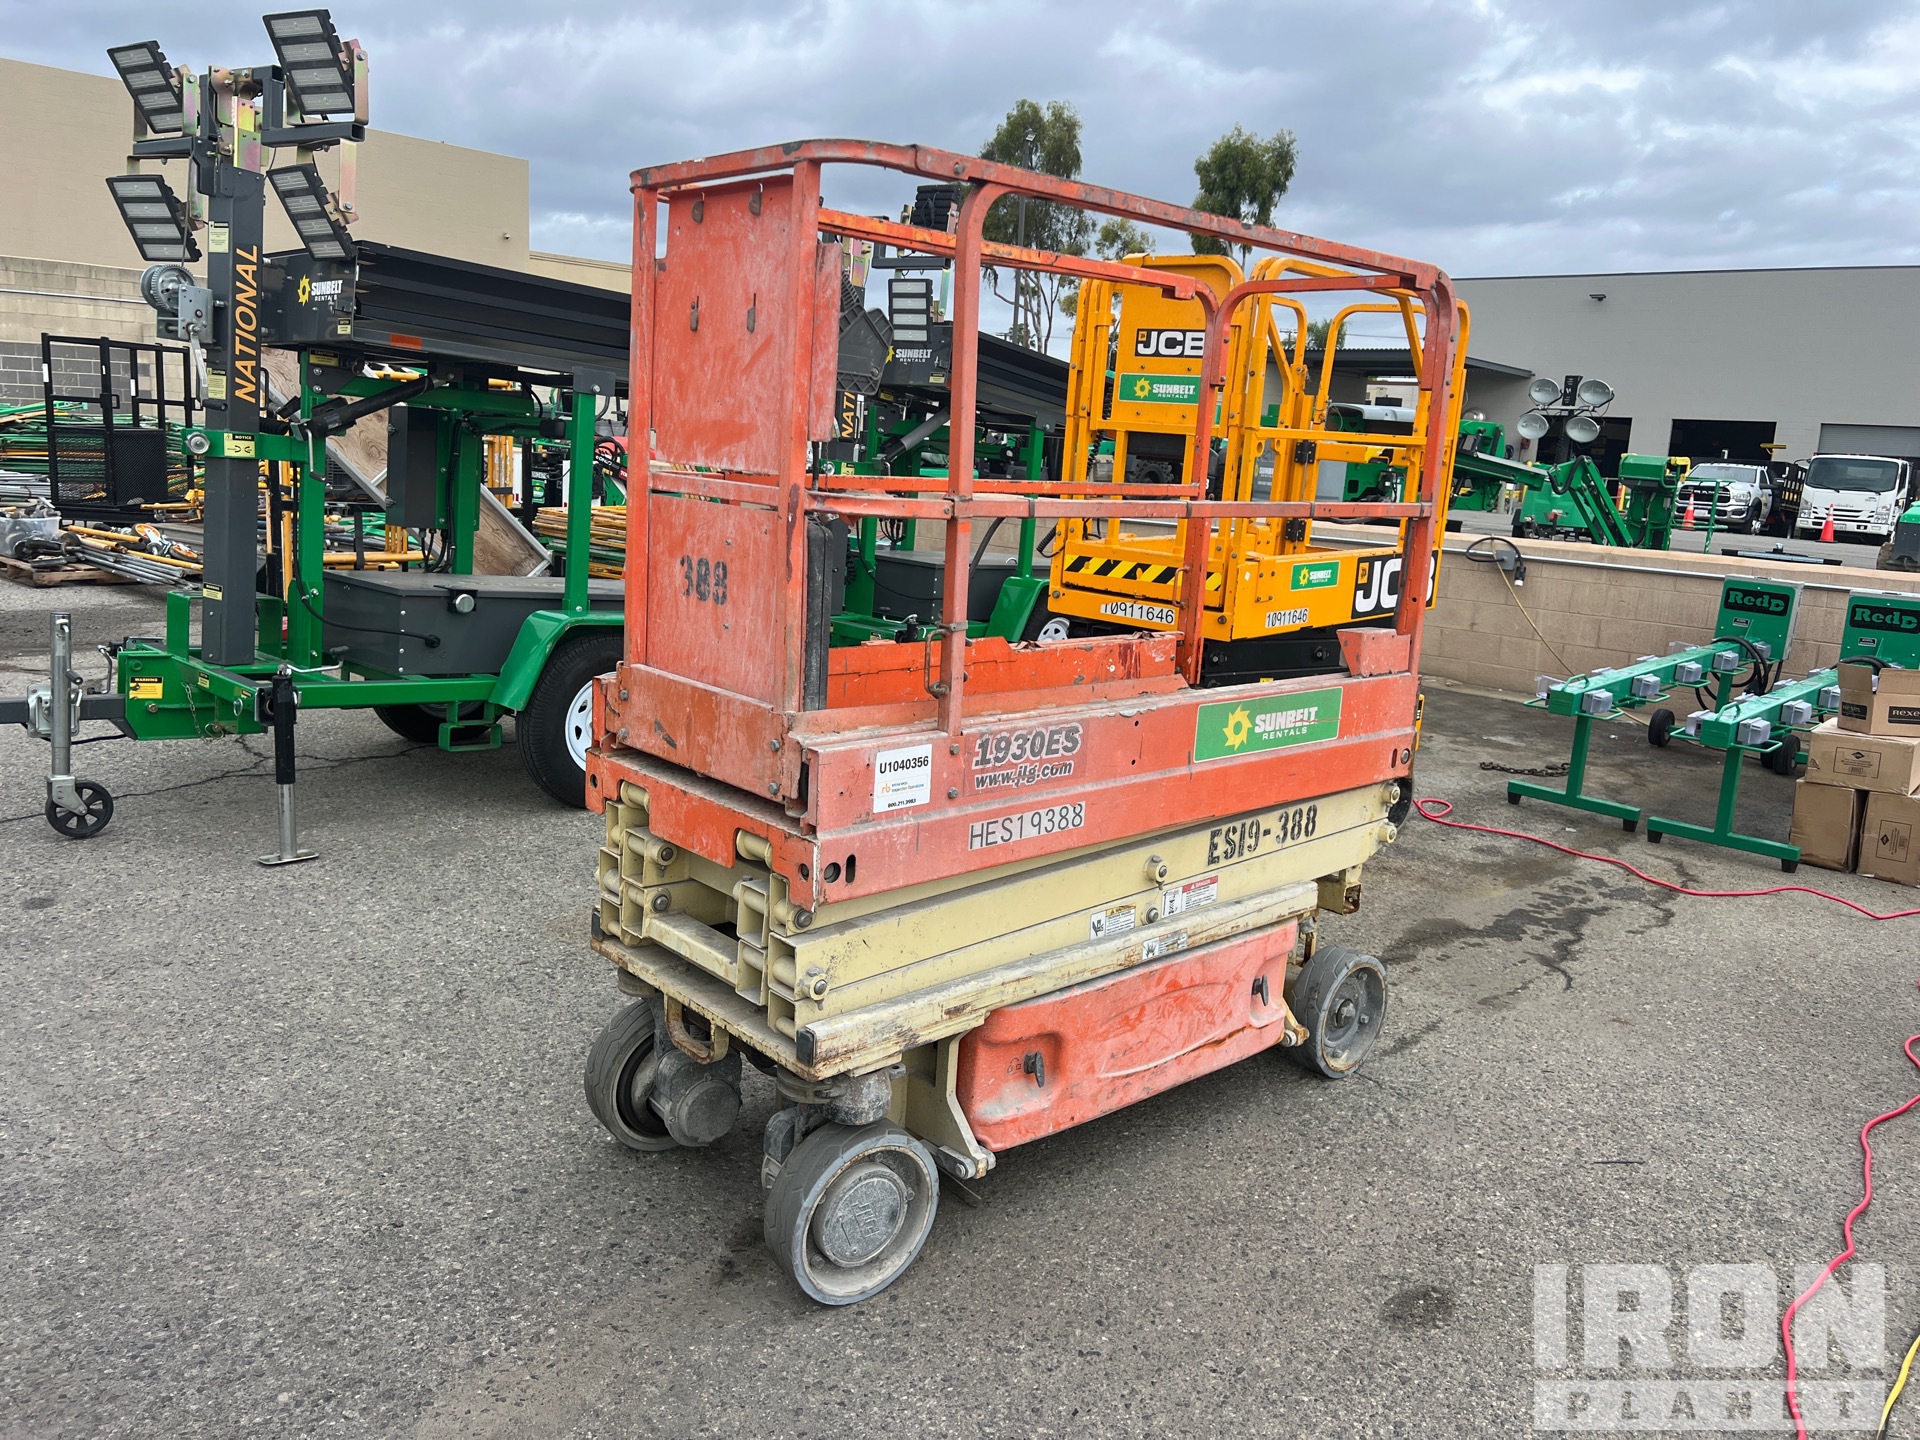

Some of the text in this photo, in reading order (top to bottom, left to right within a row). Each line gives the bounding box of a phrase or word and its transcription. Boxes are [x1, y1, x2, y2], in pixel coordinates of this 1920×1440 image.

[311, 280, 343, 296] SUNBELT
[235, 245, 258, 404] NATIONAL
[896, 348, 933, 359] SUNBELT
[1152, 384, 1196, 395] SUNBELT
[680, 554, 728, 606] 388
[1309, 569, 1332, 581] SUNBELT
[1104, 602, 1174, 624] 10911646
[1266, 609, 1309, 627] 10911646
[1254, 706, 1318, 734] SUNBELT
[1262, 726, 1308, 741] RENTALS
[973, 724, 1082, 768] 1930ES
[879, 755, 929, 774] U1040356
[975, 761, 1074, 789] www.jlg.com
[881, 782, 891, 794] rb
[969, 803, 1083, 850] HES19388
[1207, 804, 1318, 866] ES19-388
